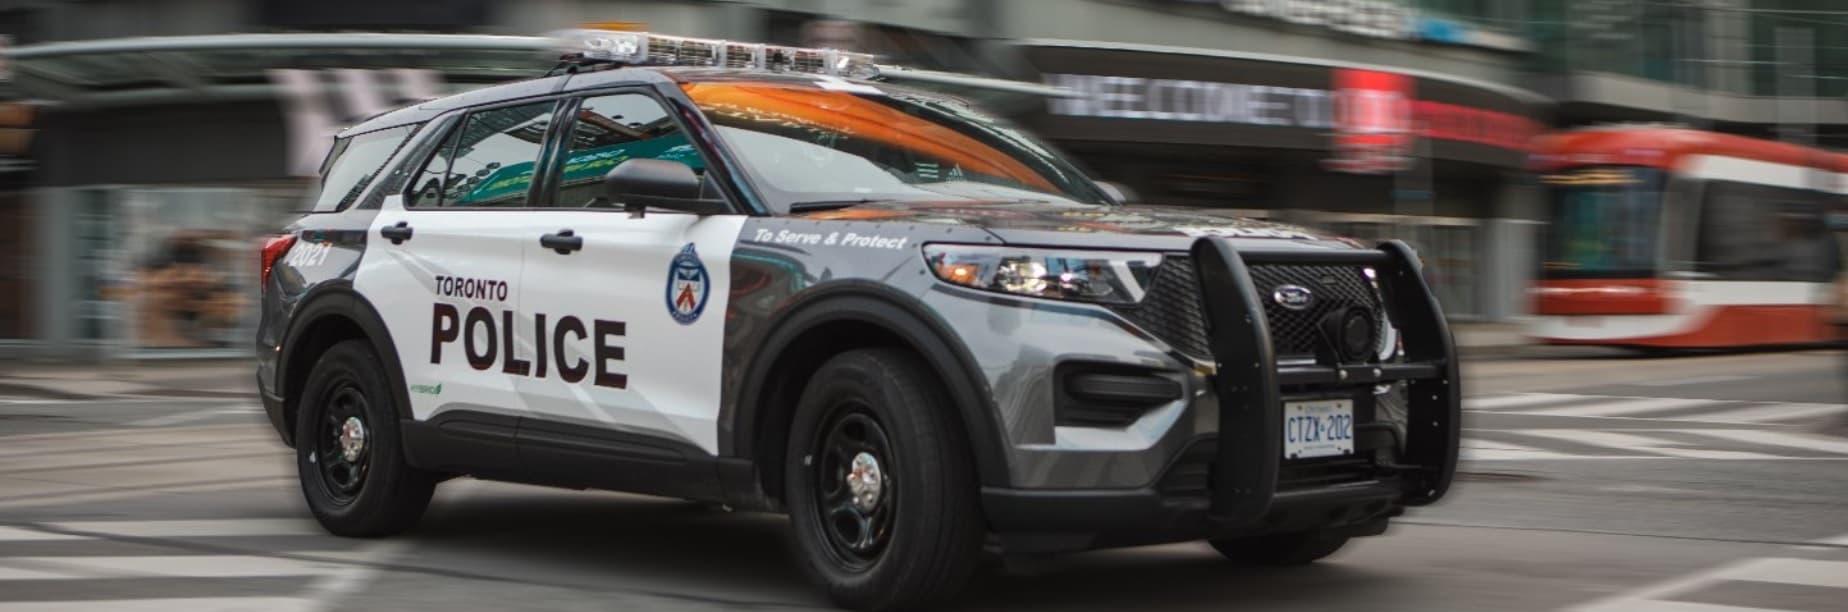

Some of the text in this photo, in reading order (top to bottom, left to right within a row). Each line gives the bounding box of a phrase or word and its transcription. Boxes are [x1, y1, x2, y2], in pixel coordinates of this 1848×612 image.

[754, 228, 908, 249] To Serve & Protect
[435, 275, 508, 302] TORONTO
[430, 302, 628, 390] POLICE
